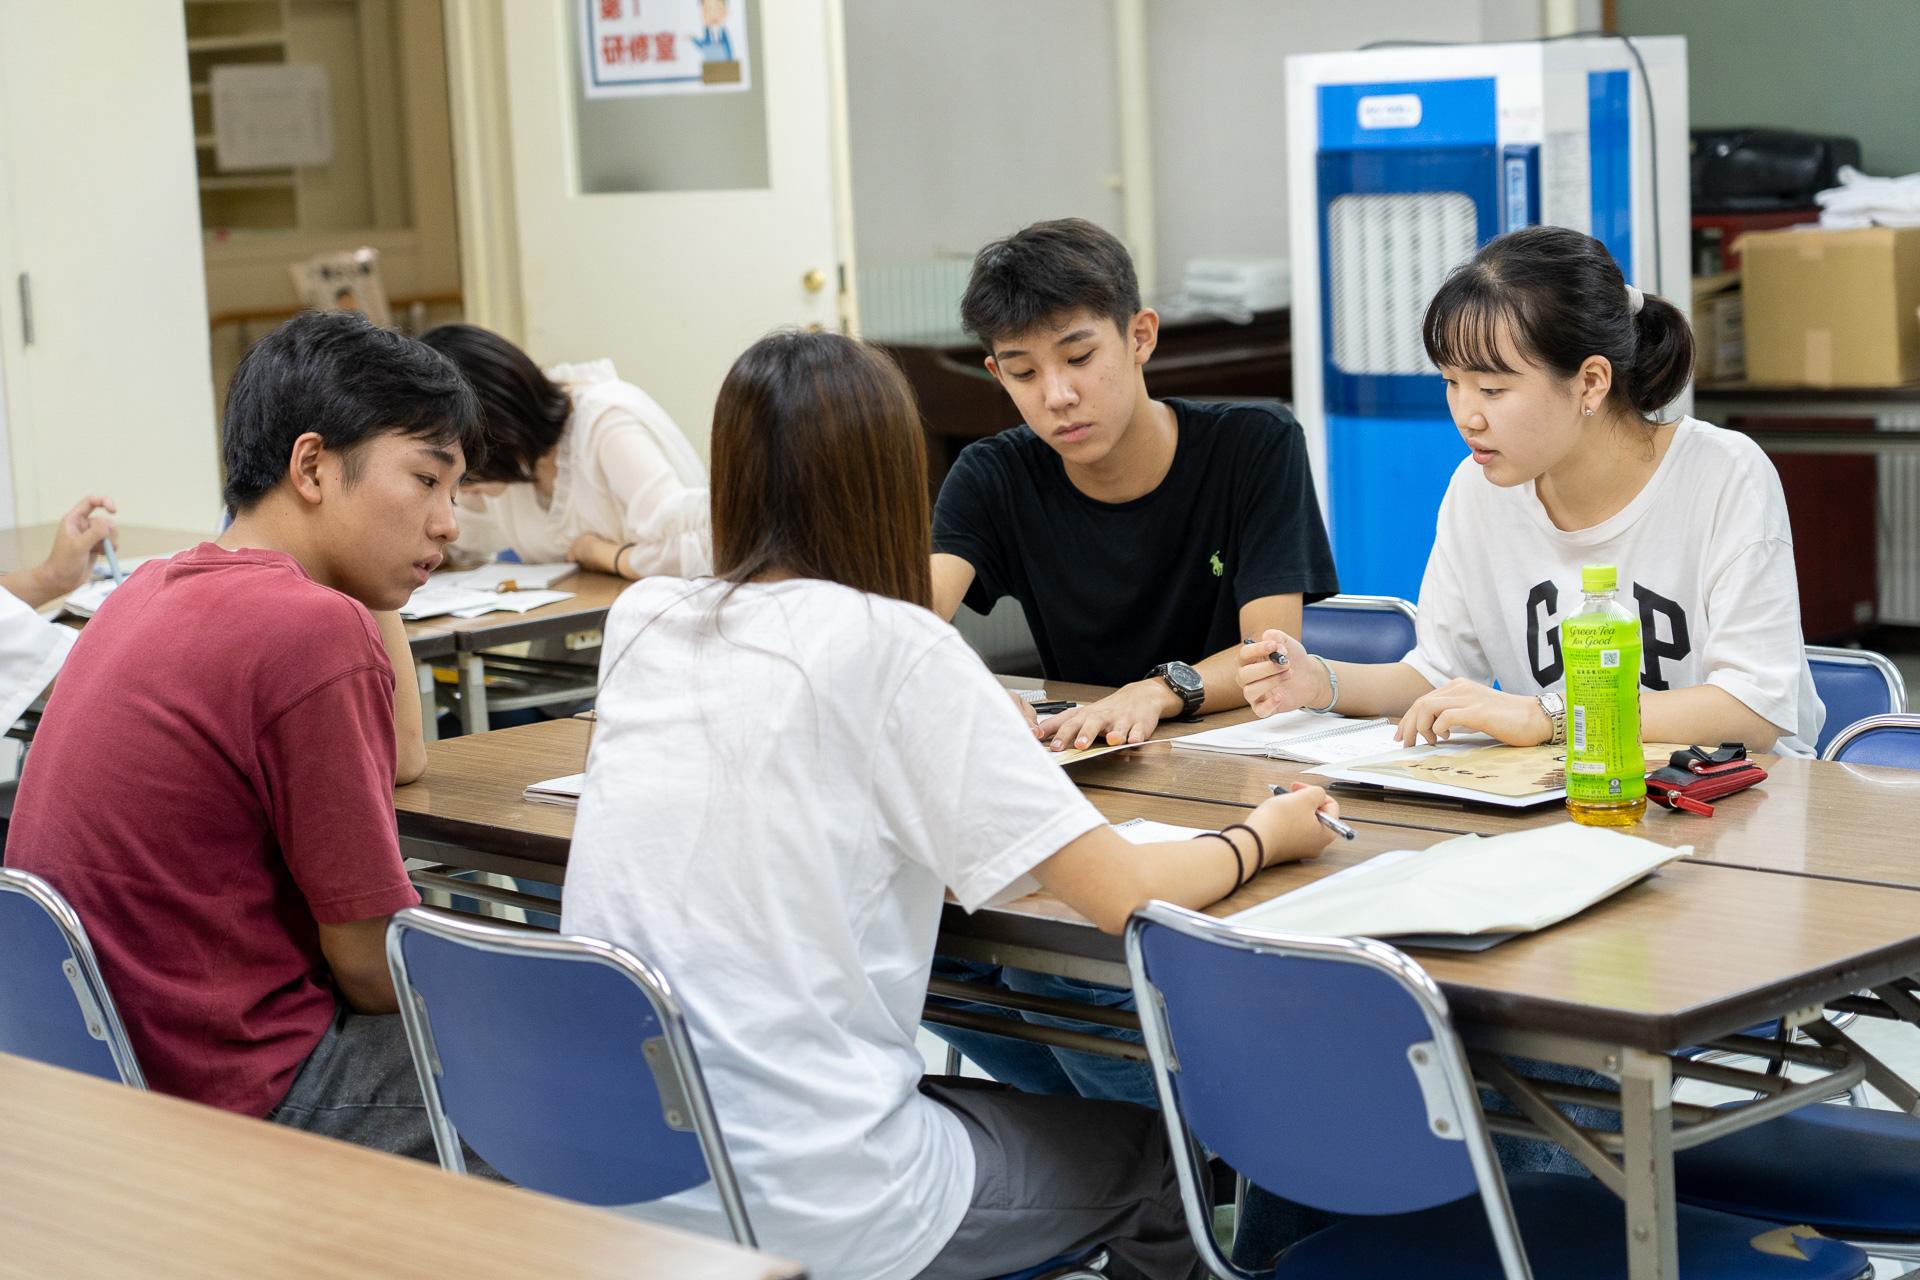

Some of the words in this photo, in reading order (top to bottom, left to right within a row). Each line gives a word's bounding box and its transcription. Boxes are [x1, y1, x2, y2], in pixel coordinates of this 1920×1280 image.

[602, 32, 676, 65] 研修室
[1527, 580, 1691, 690] GP
[1570, 625, 1596, 637] Green
[1598, 623, 1616, 636] Tea
[1572, 637, 1583, 646] for
[1585, 636, 1612, 648] Good
